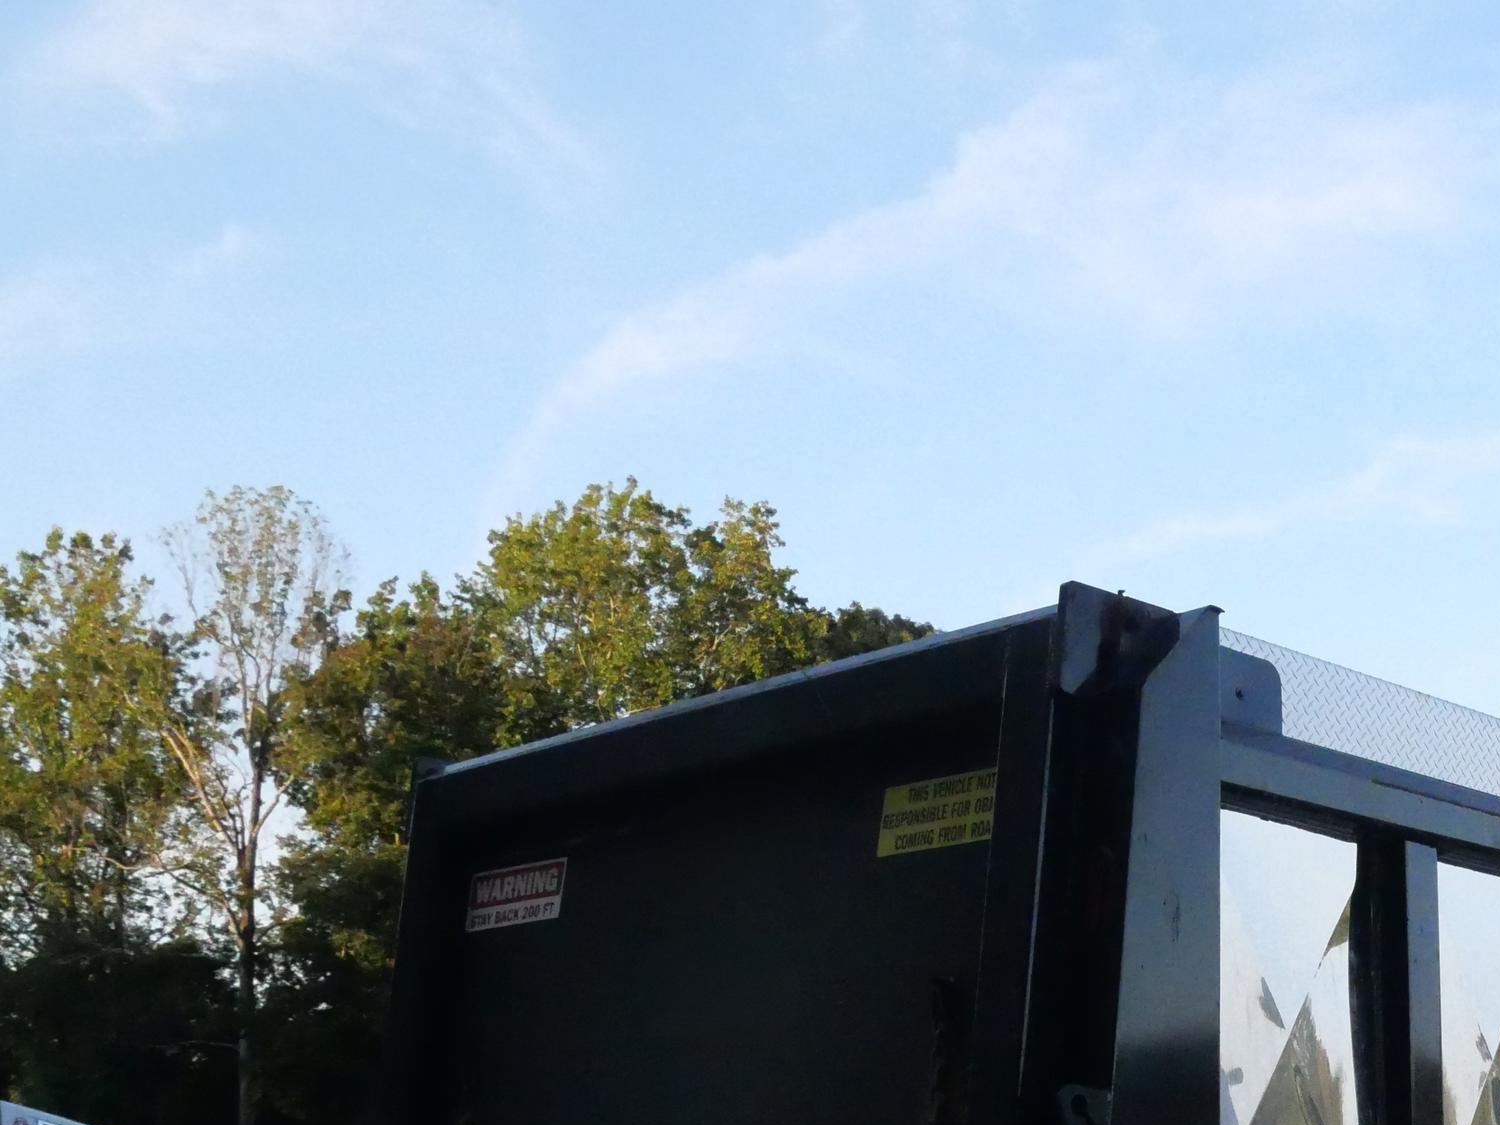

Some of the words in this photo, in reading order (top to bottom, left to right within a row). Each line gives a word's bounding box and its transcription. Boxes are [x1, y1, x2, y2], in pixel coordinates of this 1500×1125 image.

[908, 788, 929, 804] THIS
[933, 777, 974, 798] VEHICLE
[976, 772, 997, 789] NOT
[882, 804, 949, 829] RESPONSIBLE
[951, 798, 971, 817] FOR
[895, 829, 934, 850] COMING
[938, 824, 967, 843] FROM
[476, 867, 559, 904] WARNING
[471, 912, 492, 929] STAY
[495, 909, 519, 925] BACK
[521, 906, 539, 920] 200
[543, 903, 554, 917] FT
